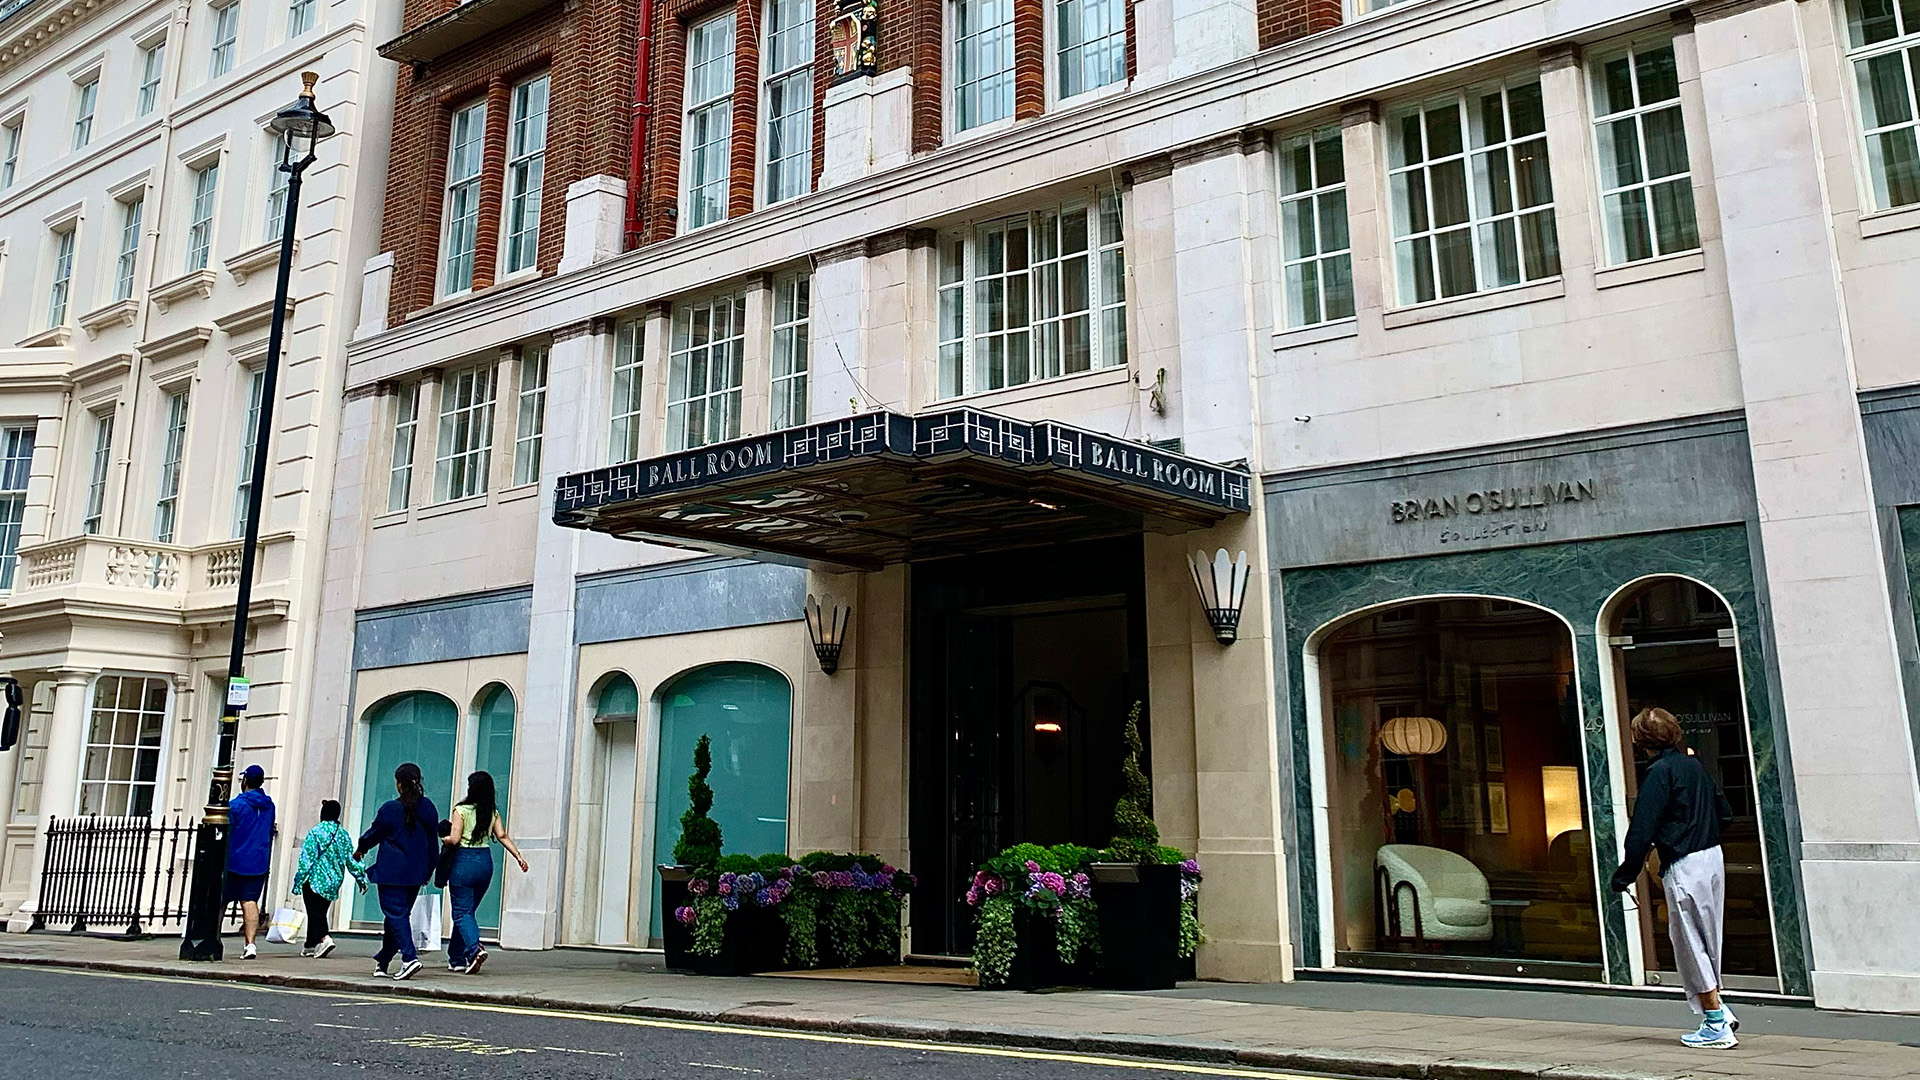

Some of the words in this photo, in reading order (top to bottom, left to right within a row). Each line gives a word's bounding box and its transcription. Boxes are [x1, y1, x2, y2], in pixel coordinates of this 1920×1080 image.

[650, 458, 701, 487] BALL
[708, 442, 771, 475] ROOM
[1092, 443, 1148, 478] BALL
[1154, 459, 1215, 495] ROOM
[1391, 495, 1459, 523] BRYAN
[1466, 479, 1596, 513] O'SULLIVAN
[1440, 522, 1547, 543] COLLECTON
[1584, 716, 1604, 733] 49
[1676, 712, 1731, 724] O'SULLIVAN
